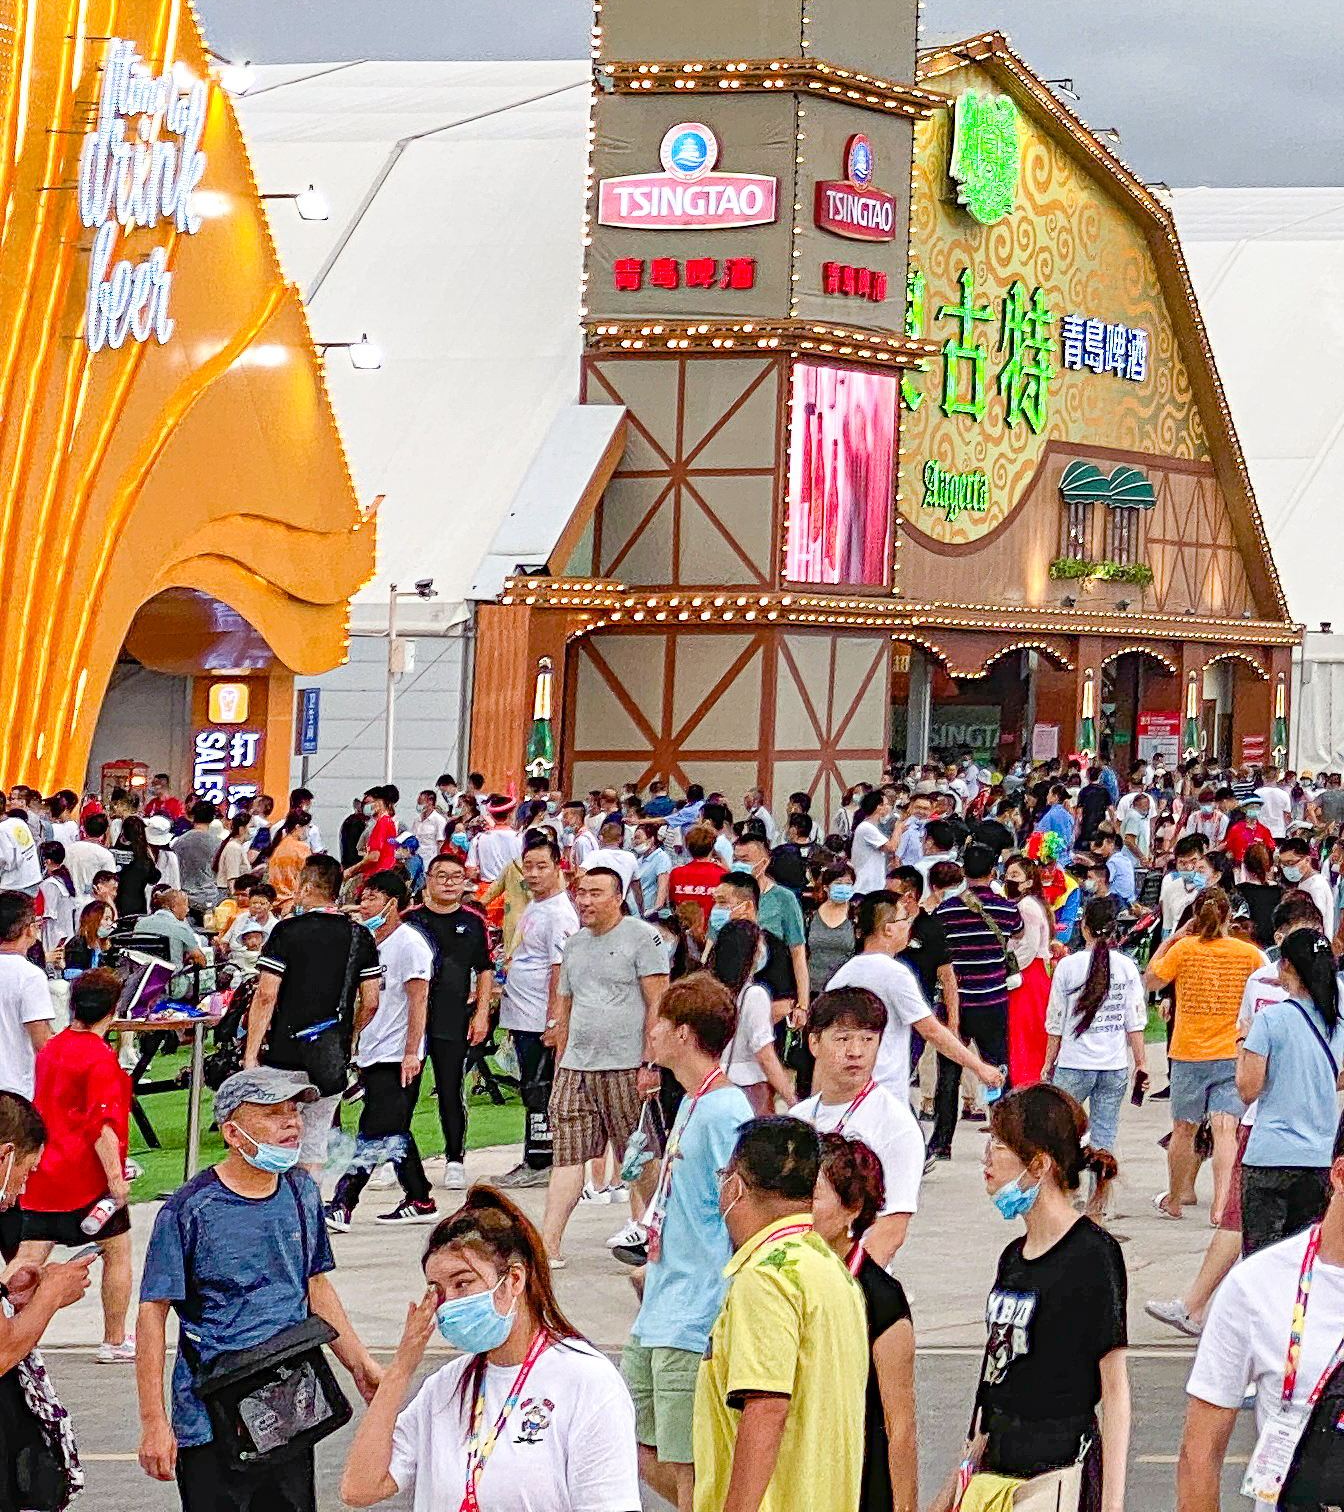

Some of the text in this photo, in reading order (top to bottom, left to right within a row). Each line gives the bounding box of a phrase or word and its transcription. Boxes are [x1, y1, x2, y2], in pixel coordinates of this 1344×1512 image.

[79, 48, 207, 234] drink
[613, 185, 763, 218] TSINGTAO
[826, 190, 893, 233] TSINGTAO
[86, 220, 174, 352] beer
[614, 257, 757, 291] 青岛啤酒
[903, 266, 1057, 435] 古特
[1062, 313, 1149, 383] 青岛啤酒
[193, 731, 227, 805] SALES
